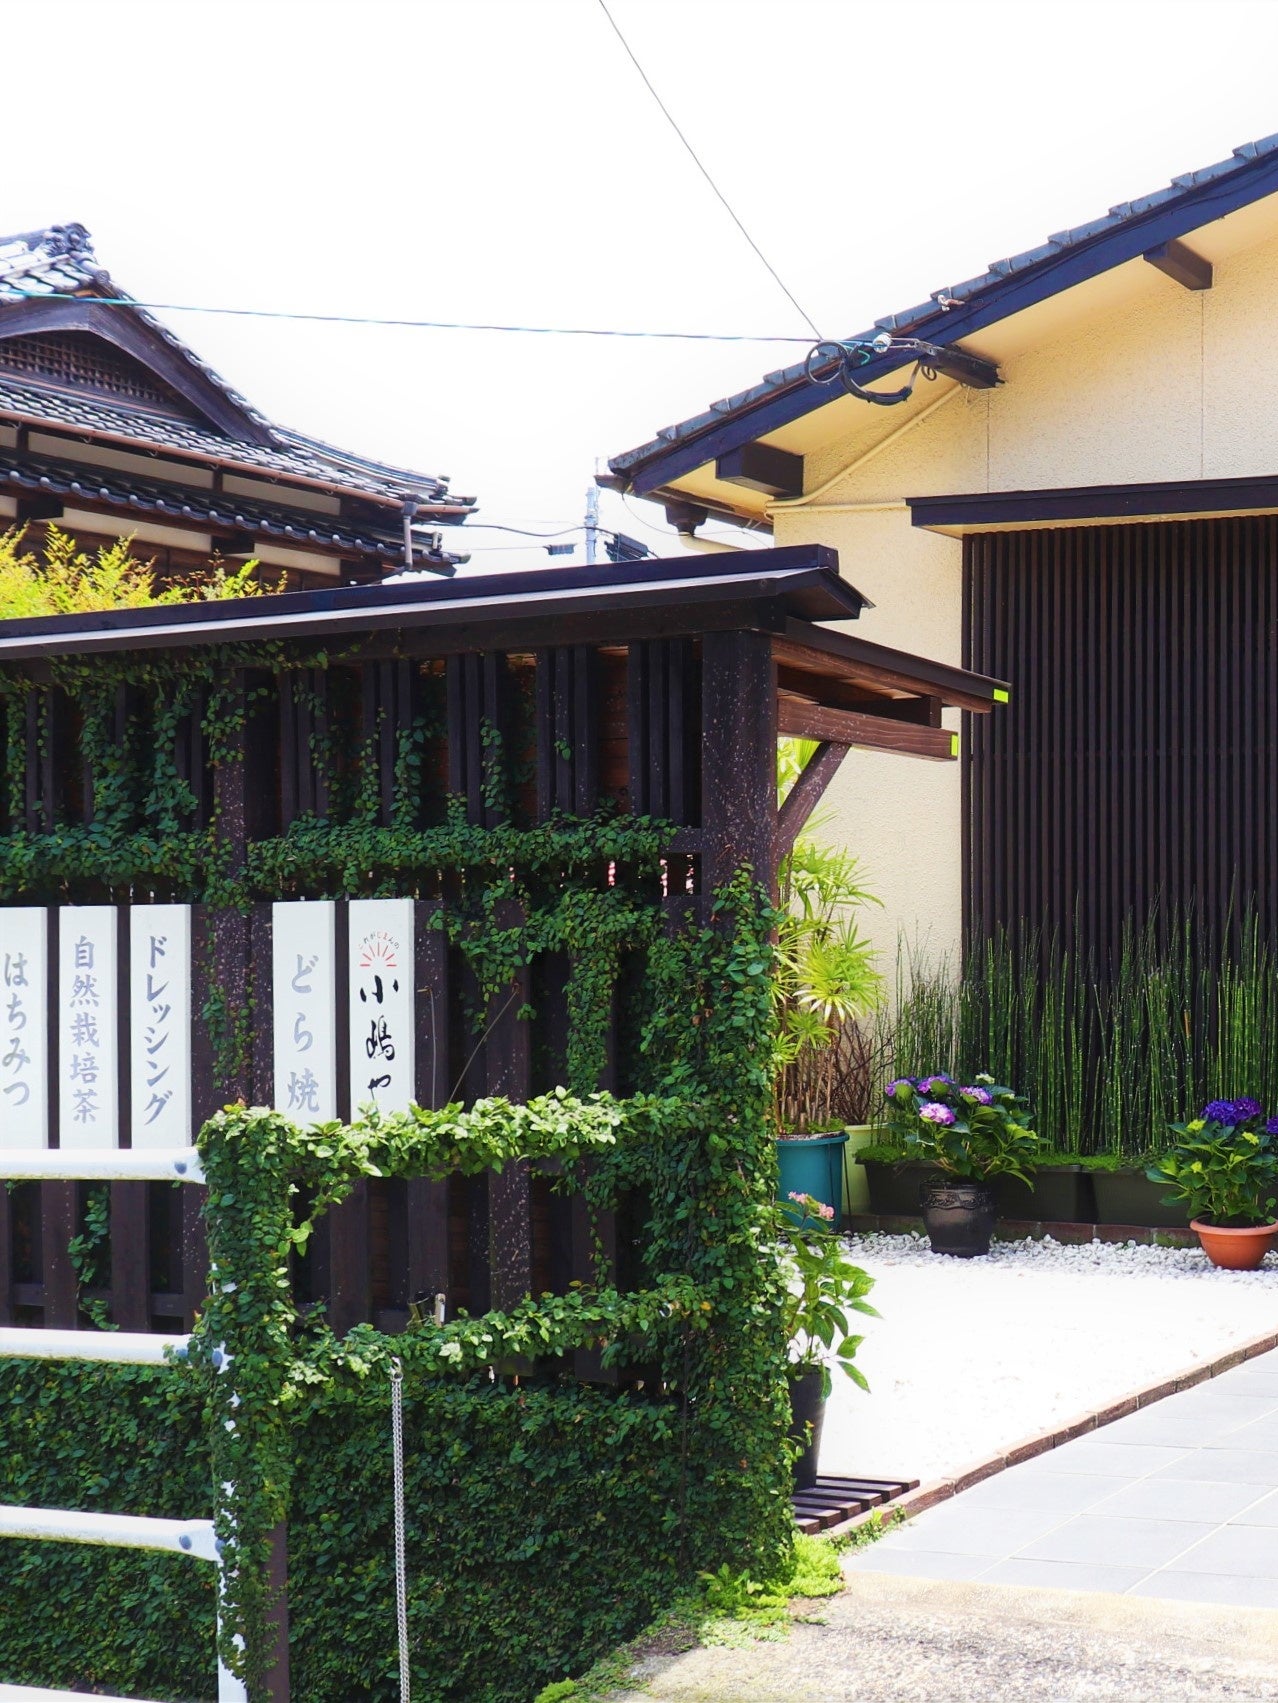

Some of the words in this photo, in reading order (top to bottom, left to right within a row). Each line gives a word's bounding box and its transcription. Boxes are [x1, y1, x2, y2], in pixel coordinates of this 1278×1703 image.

[2, 952, 30, 1106] はちみつ
[69, 935, 100, 1123] 自然栽培茶
[143, 935, 173, 1126] ドレッシング
[286, 954, 320, 1113] どら焼
[359, 974, 399, 1105] 小嶋や
